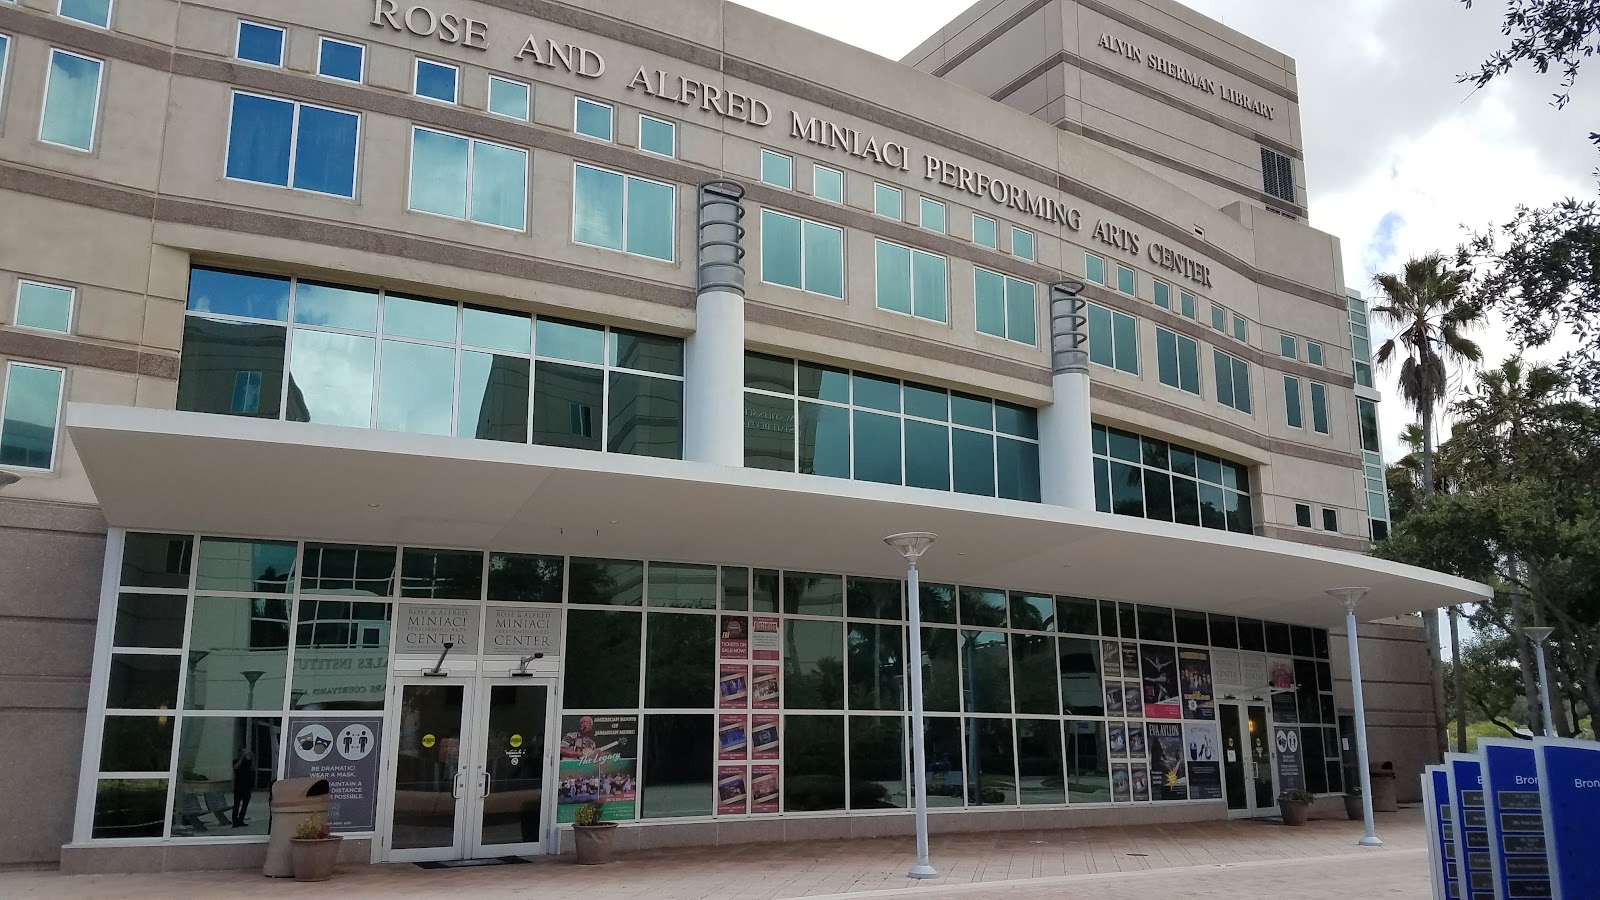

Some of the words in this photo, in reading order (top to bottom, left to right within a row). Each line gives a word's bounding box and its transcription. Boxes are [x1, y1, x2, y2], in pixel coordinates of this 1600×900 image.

[1098, 32, 1142, 63] ALVIN
[1147, 53, 1216, 95] SHERMAN
[1220, 84, 1274, 120] LIBRARY
[369, 0, 490, 51] ROSE
[513, 33, 606, 79] AND
[626, 64, 772, 127] ALFRED
[789, 110, 910, 172] MINIACI
[923, 154, 1082, 232] PERFORMING
[1092, 217, 1140, 256] ARTS
[1148, 241, 1213, 288] CENTER
[408, 608, 429, 616] ROSE
[496, 611, 515, 619] ROSE
[407, 617, 467, 627] MINIACI
[495, 619, 550, 629] MINIACI
[406, 633, 467, 645] CENTER
[494, 635, 550, 646] CENTER
[578, 755, 592, 766] The
[593, 752, 621, 765] Legacy
[1574, 778, 1600, 788] Bron
